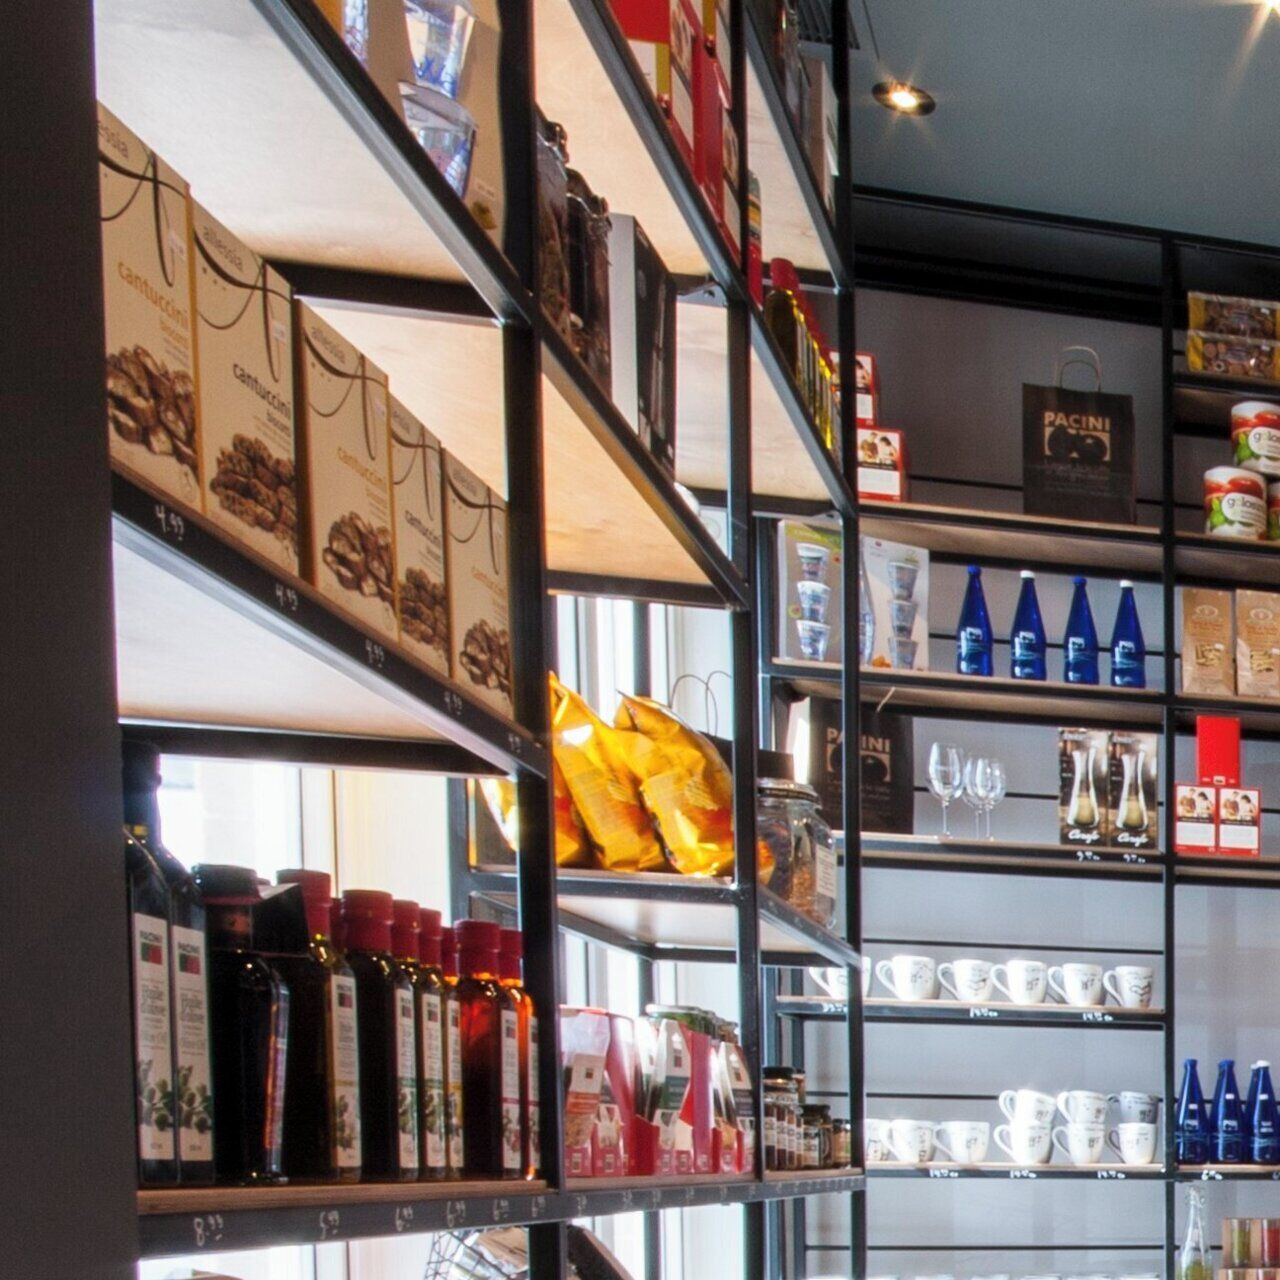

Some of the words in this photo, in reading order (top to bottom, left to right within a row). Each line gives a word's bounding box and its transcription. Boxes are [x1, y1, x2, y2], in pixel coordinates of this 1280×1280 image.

[116, 260, 190, 329] cantuccini
[232, 363, 291, 420] cantuccini
[1044, 411, 1110, 431] PACINI
[826, 727, 891, 753] PINI
